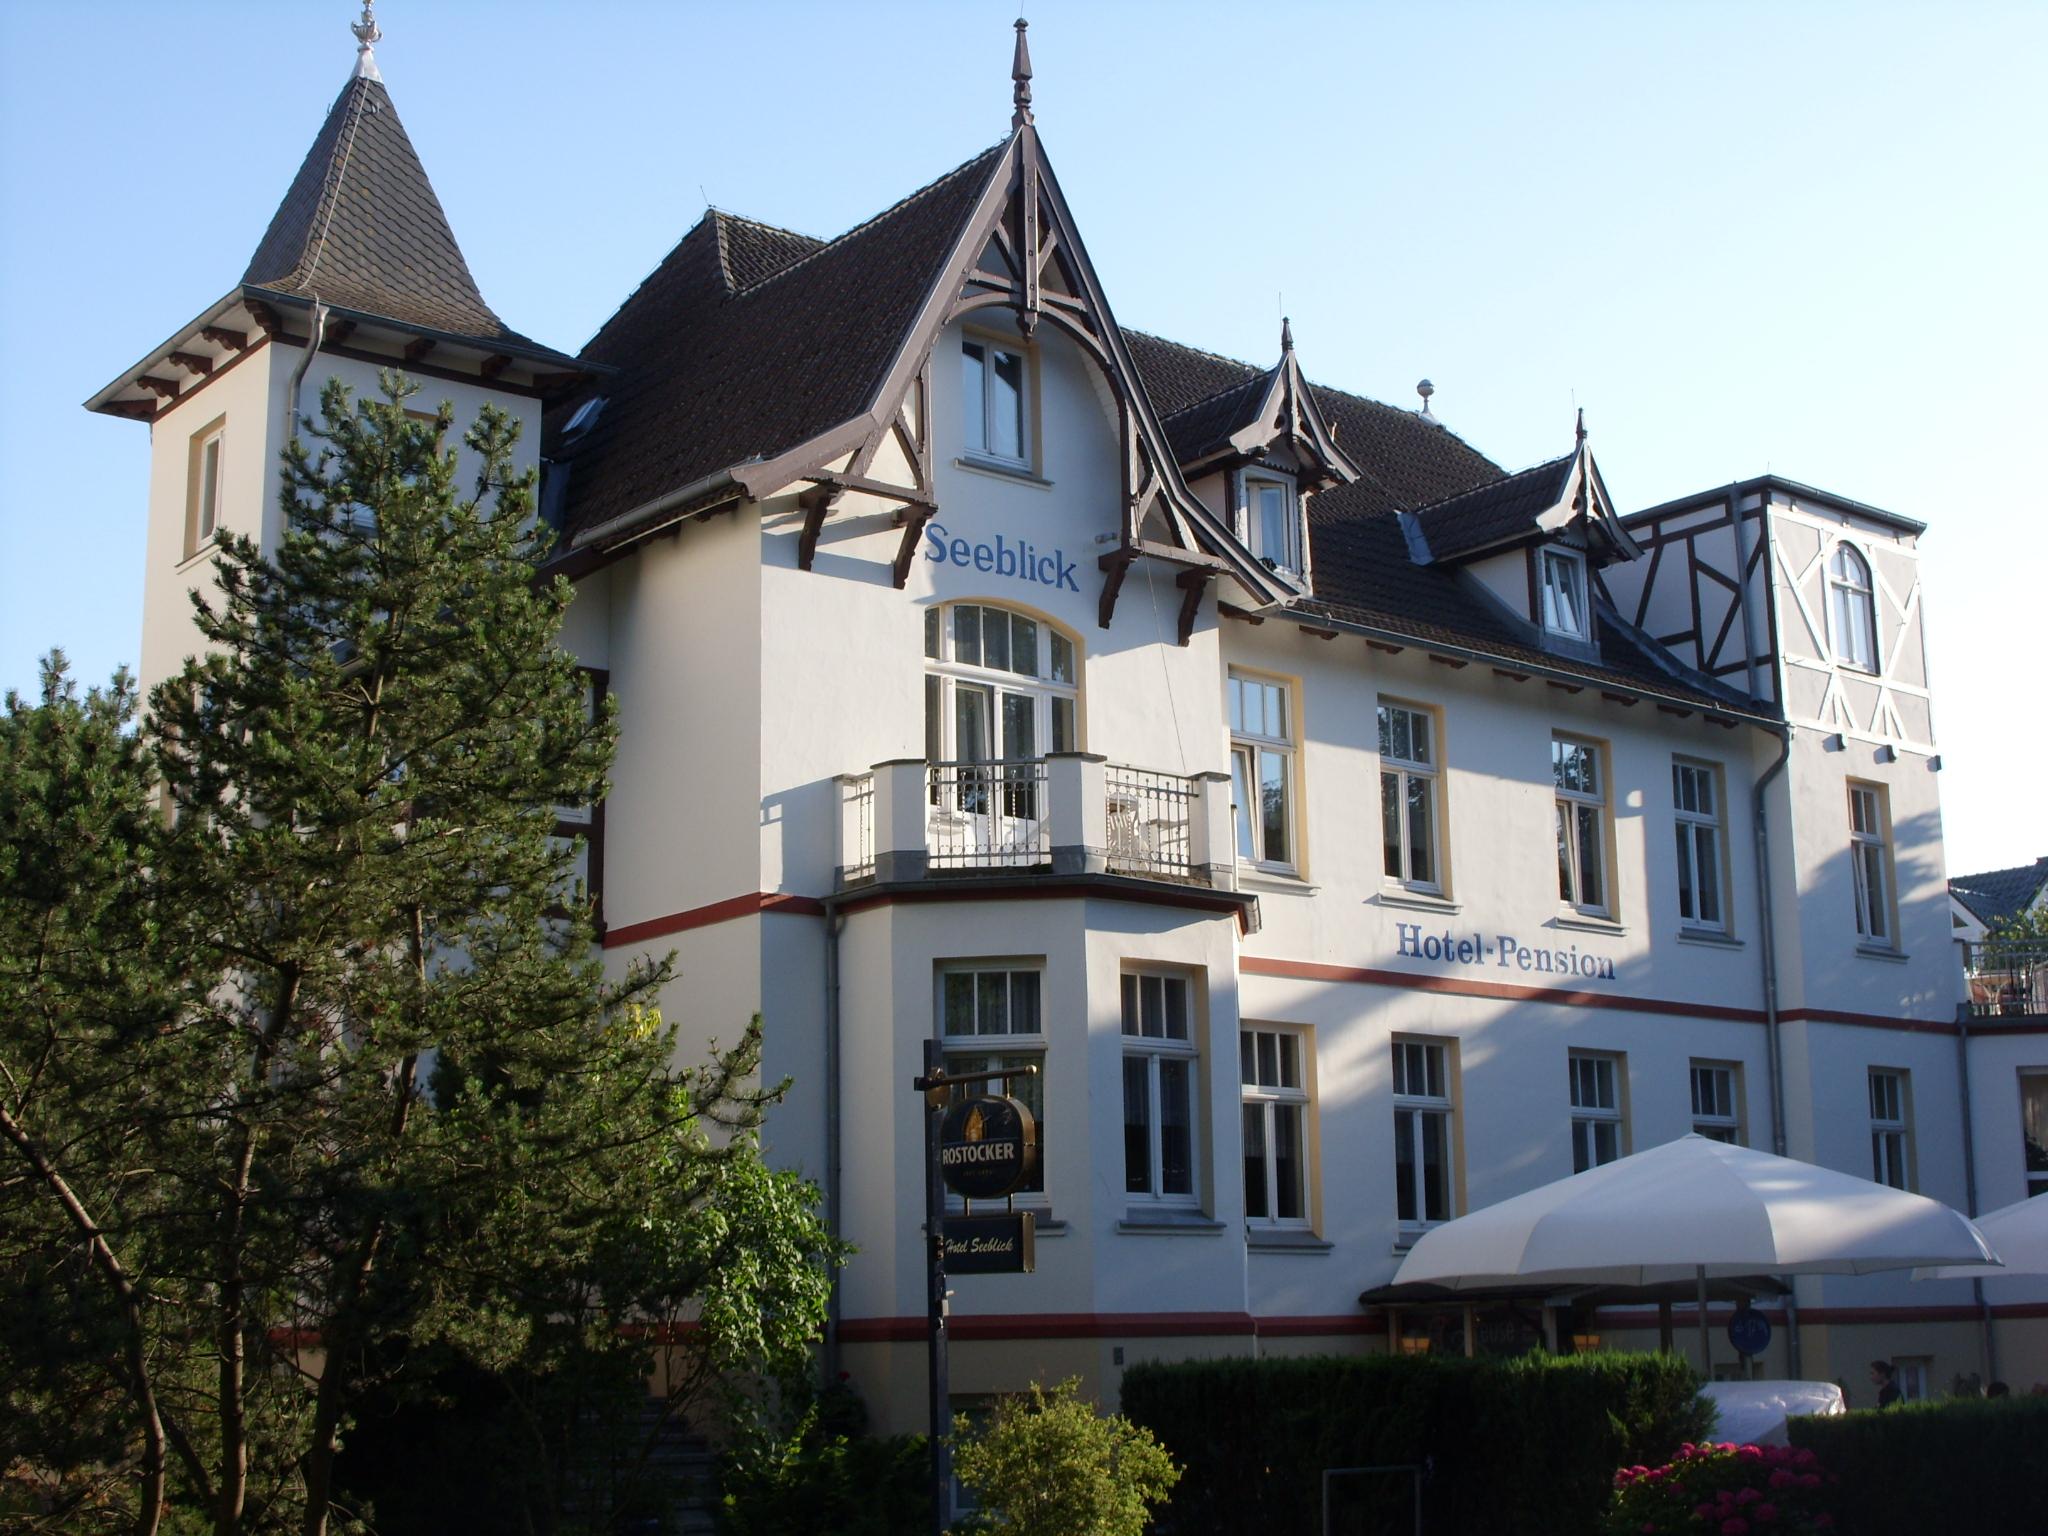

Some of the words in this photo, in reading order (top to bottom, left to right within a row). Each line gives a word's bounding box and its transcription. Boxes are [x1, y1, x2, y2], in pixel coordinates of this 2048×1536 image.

[925, 523, 1080, 592] Seeblick
[1396, 922, 1616, 980] Hotel-Pension
[942, 1142, 1015, 1166] ROSTOCKER
[945, 1238, 969, 1254] Hotel
[970, 1236, 1014, 1253] Seeblick
